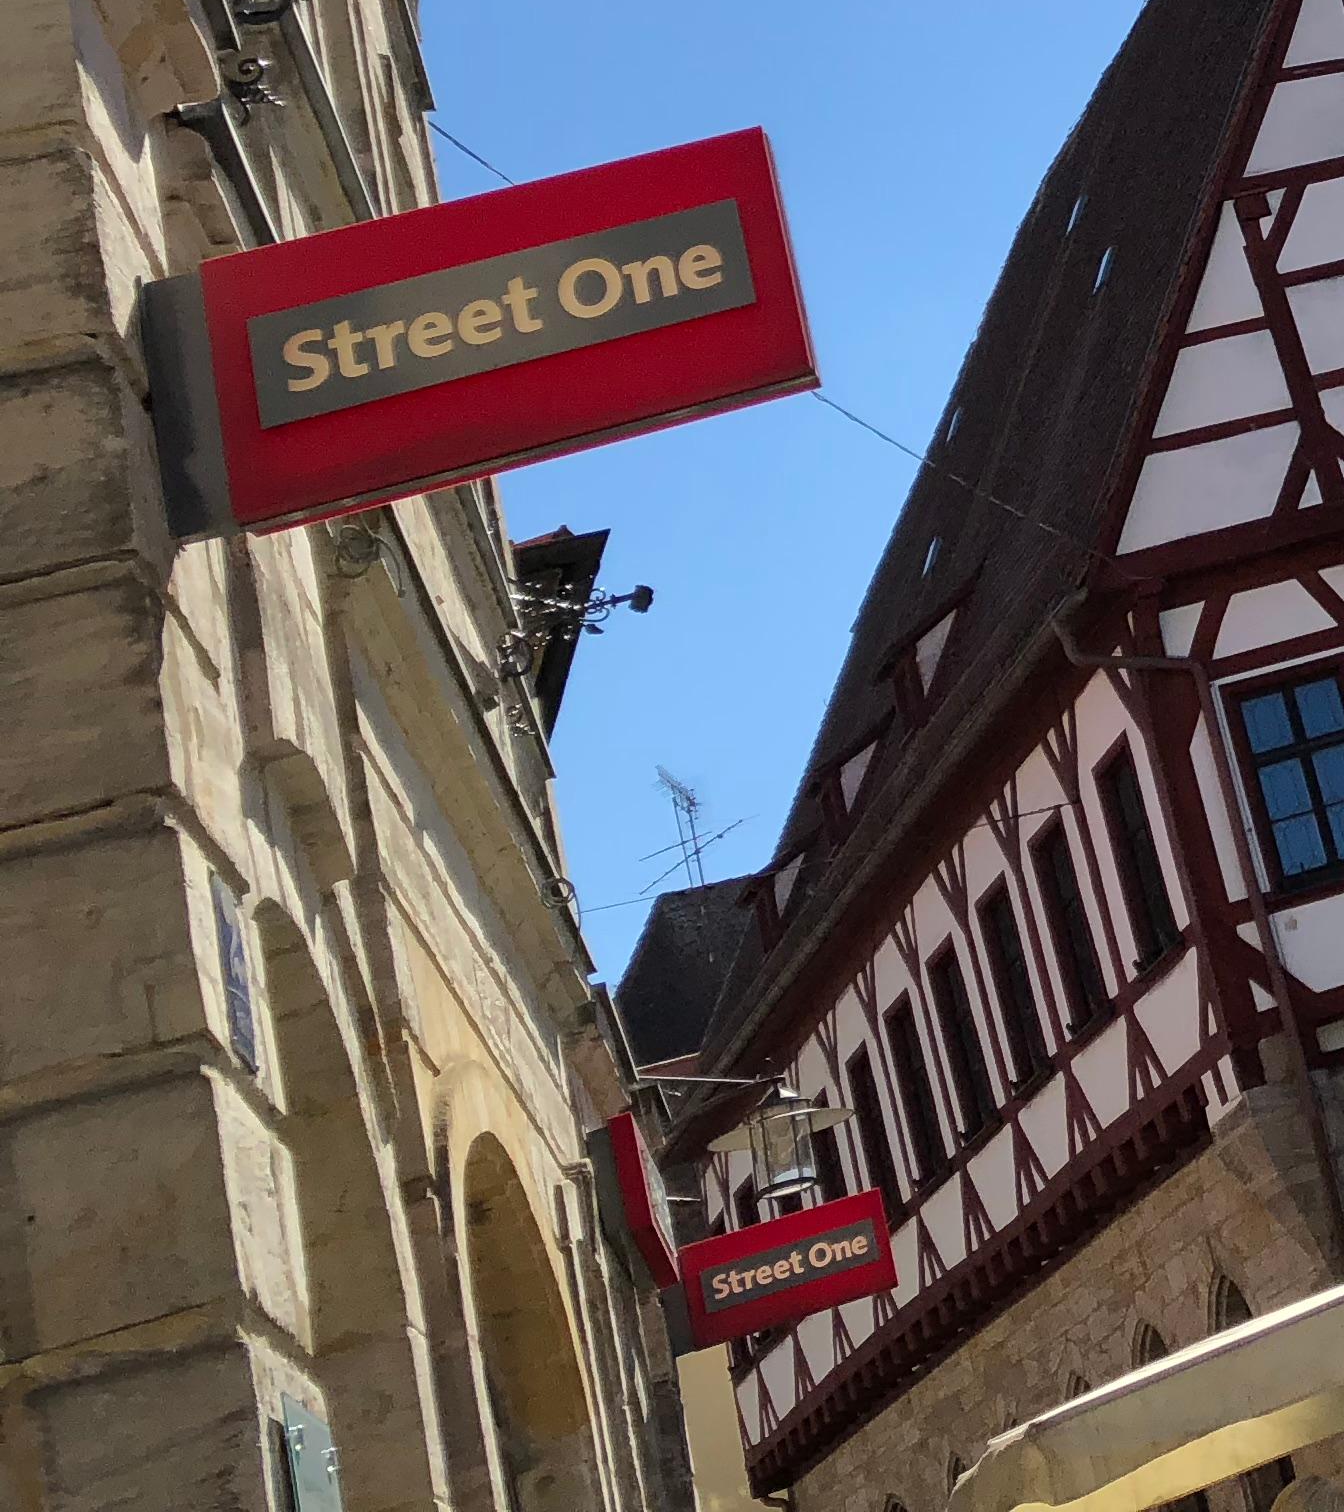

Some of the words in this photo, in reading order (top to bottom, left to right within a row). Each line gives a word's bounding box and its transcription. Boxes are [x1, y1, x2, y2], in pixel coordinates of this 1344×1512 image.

[283, 276, 543, 392] Street
[558, 243, 724, 319] One
[712, 1251, 804, 1300] Street
[808, 1234, 869, 1268] One
